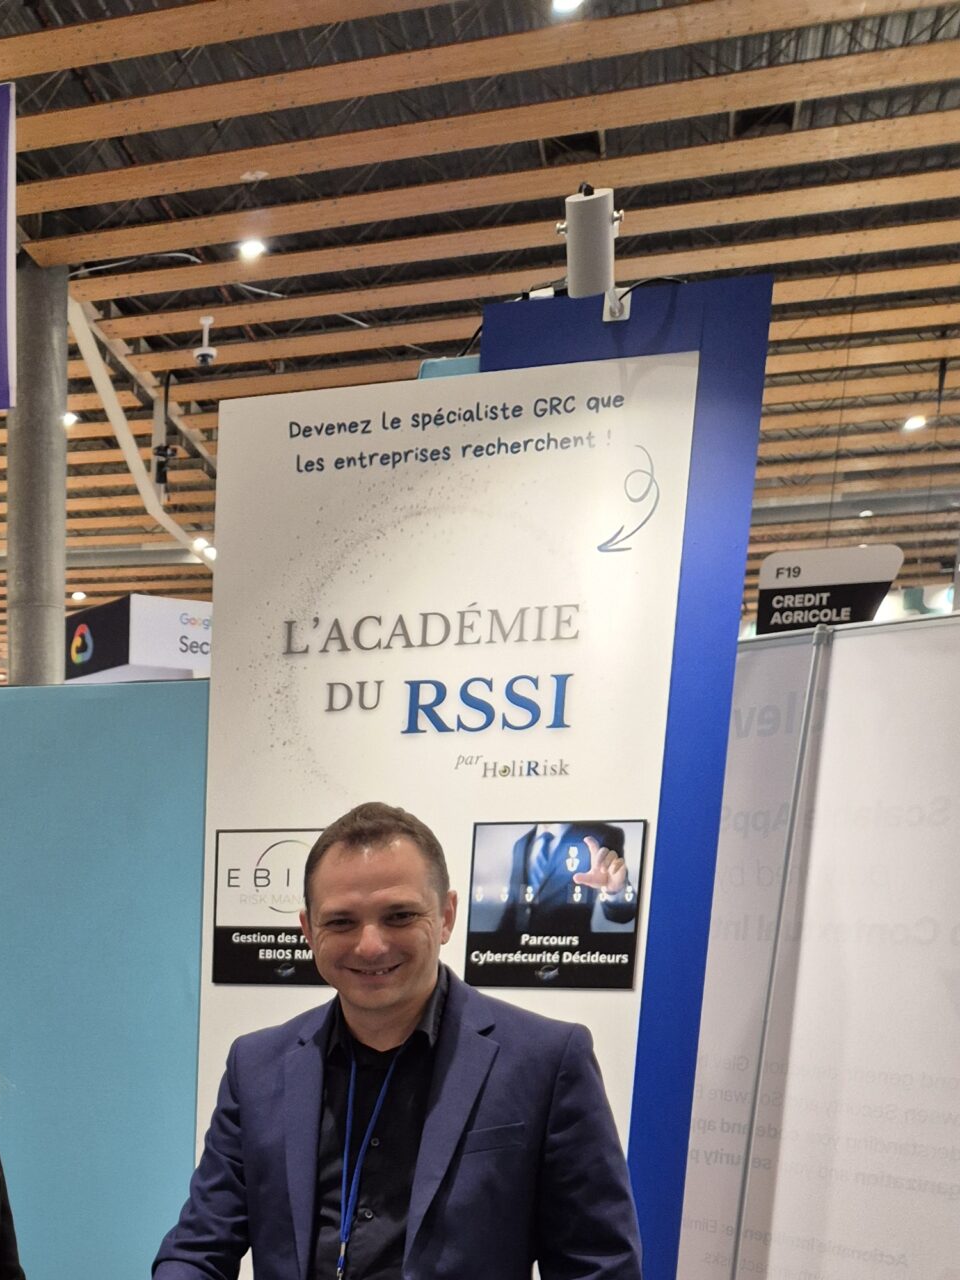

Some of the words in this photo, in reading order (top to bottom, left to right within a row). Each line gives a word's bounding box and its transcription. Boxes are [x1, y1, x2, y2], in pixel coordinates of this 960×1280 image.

[288, 418, 373, 439] Devenez
[381, 411, 402, 432] le
[410, 399, 524, 431] spécialiste
[533, 395, 577, 417] GRC
[586, 392, 626, 415] que
[295, 453, 325, 474] les
[334, 444, 452, 476] entreprises
[460, 431, 596, 459] recherchent
[775, 566, 802, 580] F19
[771, 592, 831, 609] CREDIT
[769, 607, 852, 626] AGRICOLE
[282, 601, 581, 656] L'ACADÉMIE
[325, 679, 384, 713] DU
[400, 673, 575, 735] RSSI
[454, 752, 483, 772] par
[231, 931, 276, 944] Gestion
[277, 931, 298, 944] des
[520, 933, 580, 947] Parcours
[258, 948, 292, 960] EBIOS
[470, 950, 560, 965] Cybersécurité
[562, 951, 630, 965] Décideurs
